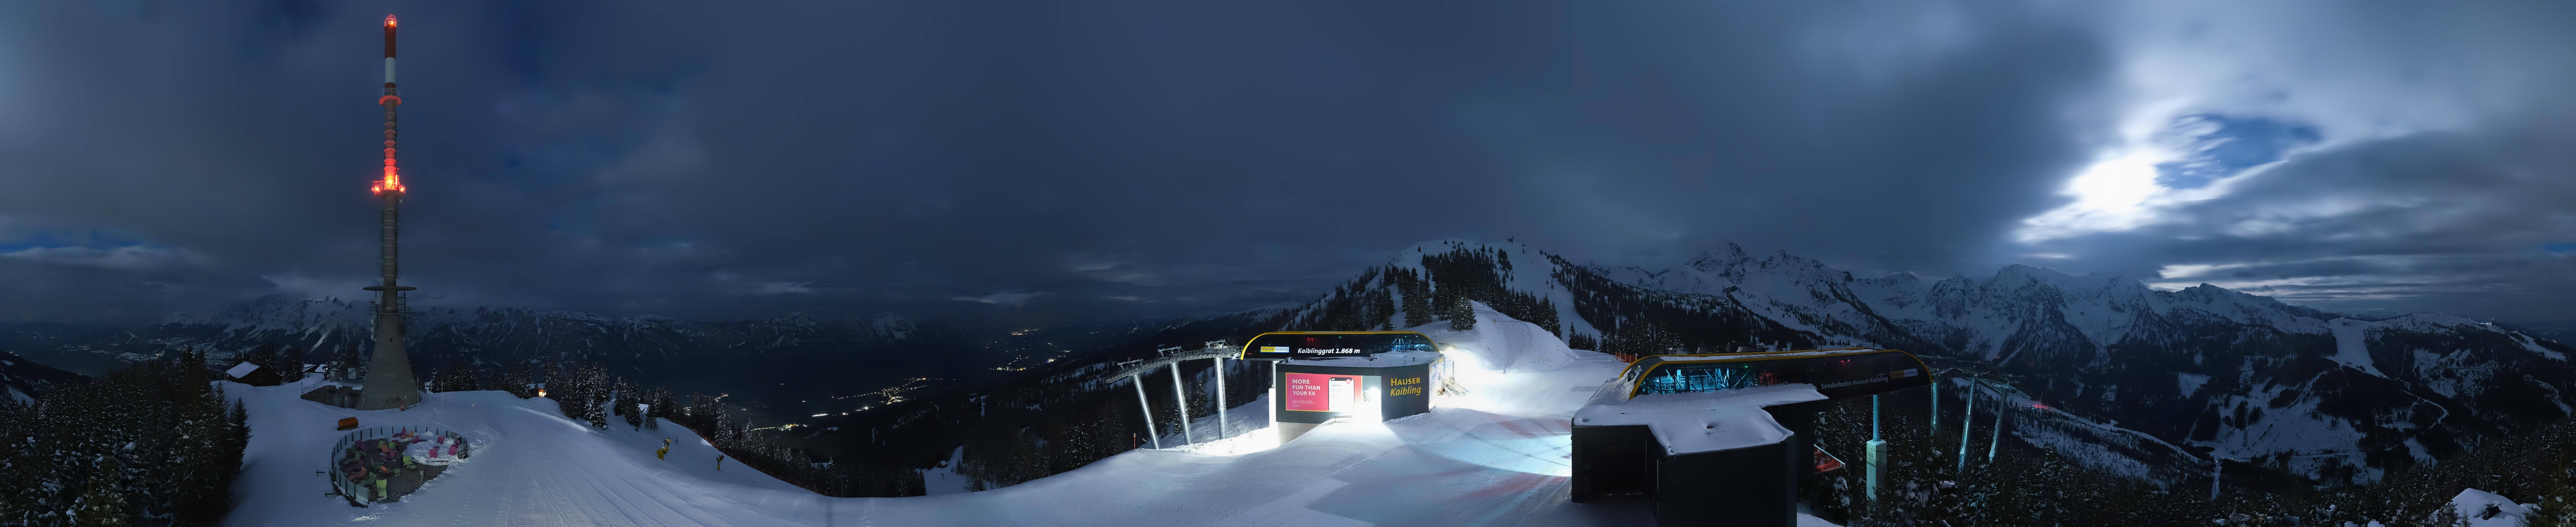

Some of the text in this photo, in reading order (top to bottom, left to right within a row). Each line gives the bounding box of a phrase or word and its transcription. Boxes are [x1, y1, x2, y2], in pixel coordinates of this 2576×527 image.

[1391, 377, 1420, 386] HAUSER
[1821, 380, 1851, 389] Senderbahn
[1391, 386, 1421, 396] Kaibling
